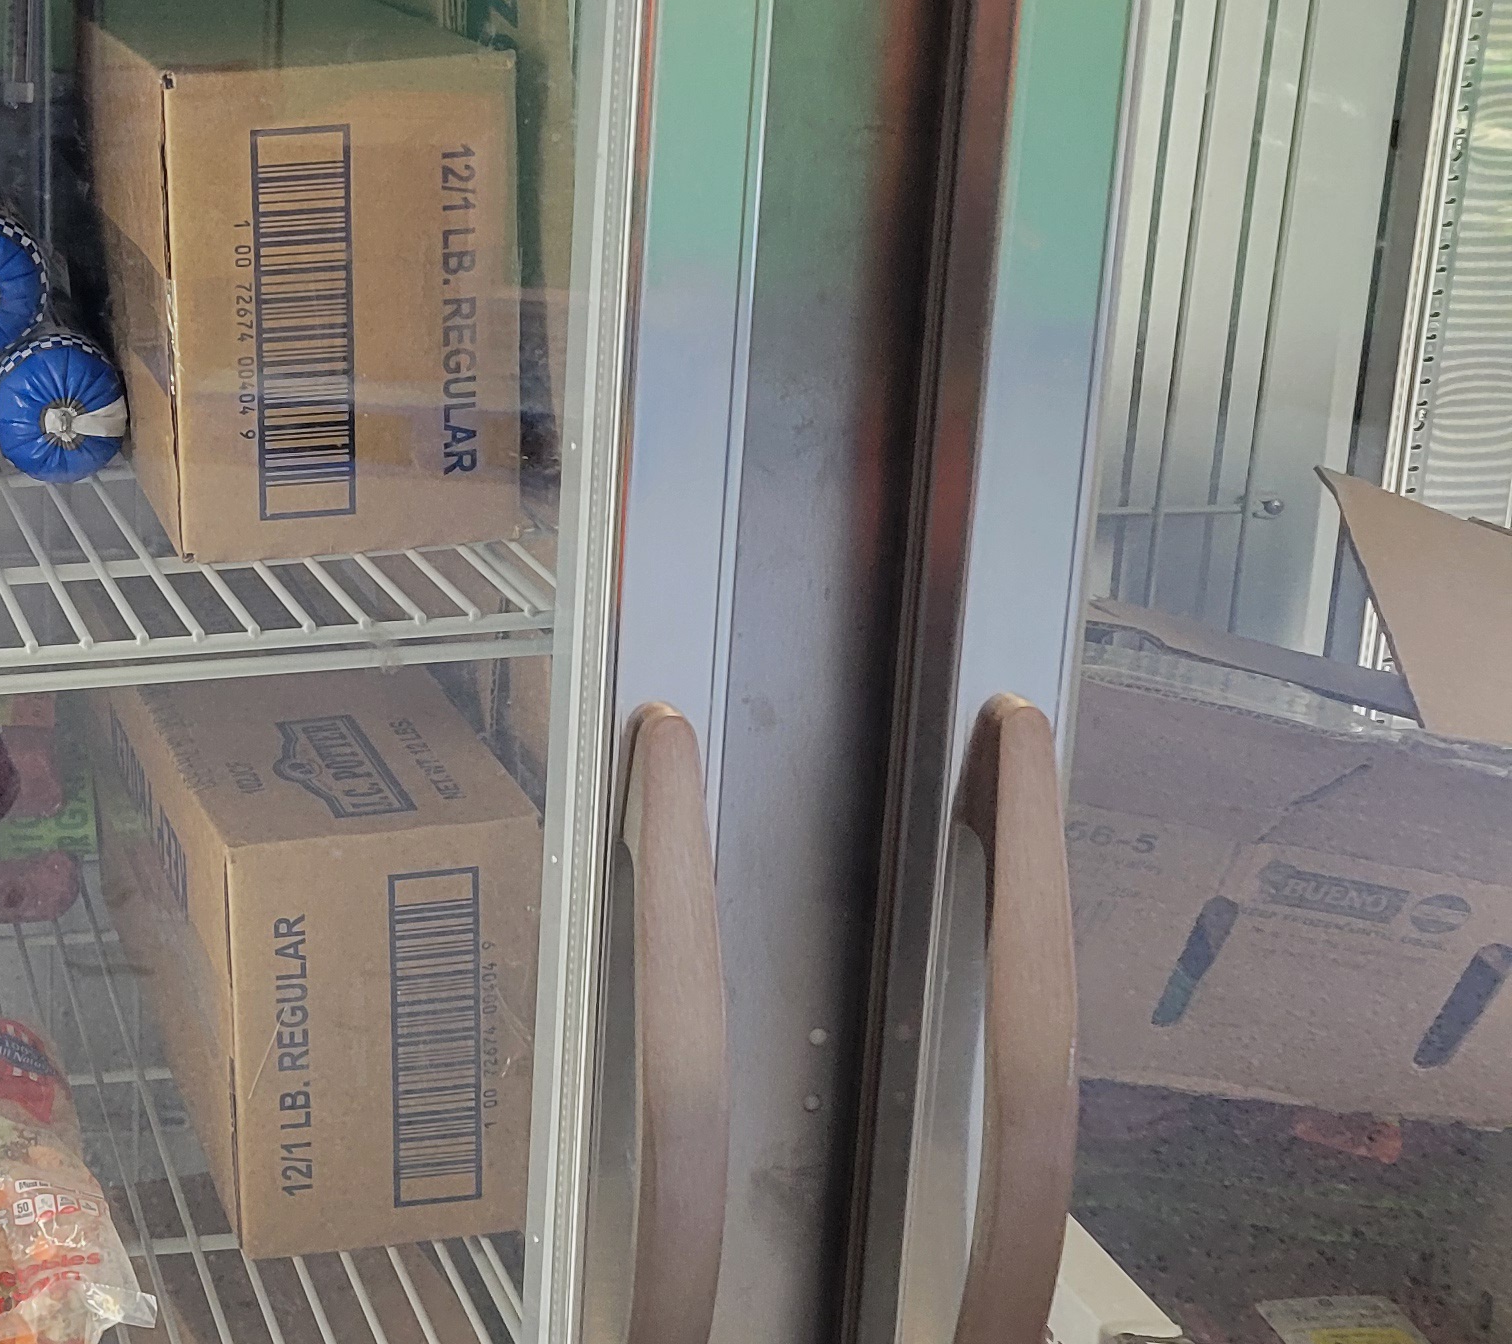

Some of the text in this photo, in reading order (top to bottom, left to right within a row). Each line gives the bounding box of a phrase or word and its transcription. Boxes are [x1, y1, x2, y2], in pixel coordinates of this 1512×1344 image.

[234, 244, 253, 268] 00
[235, 282, 254, 343] 72674
[439, 144, 480, 477] 12/1 LB. REGULAR
[237, 356, 256, 416] 00404
[1285, 875, 1393, 919] BUENO
[272, 913, 314, 1199] REGULAR LB. 12/1
[483, 1088, 497, 1109] 00
[16, 1201, 29, 1214] 50
